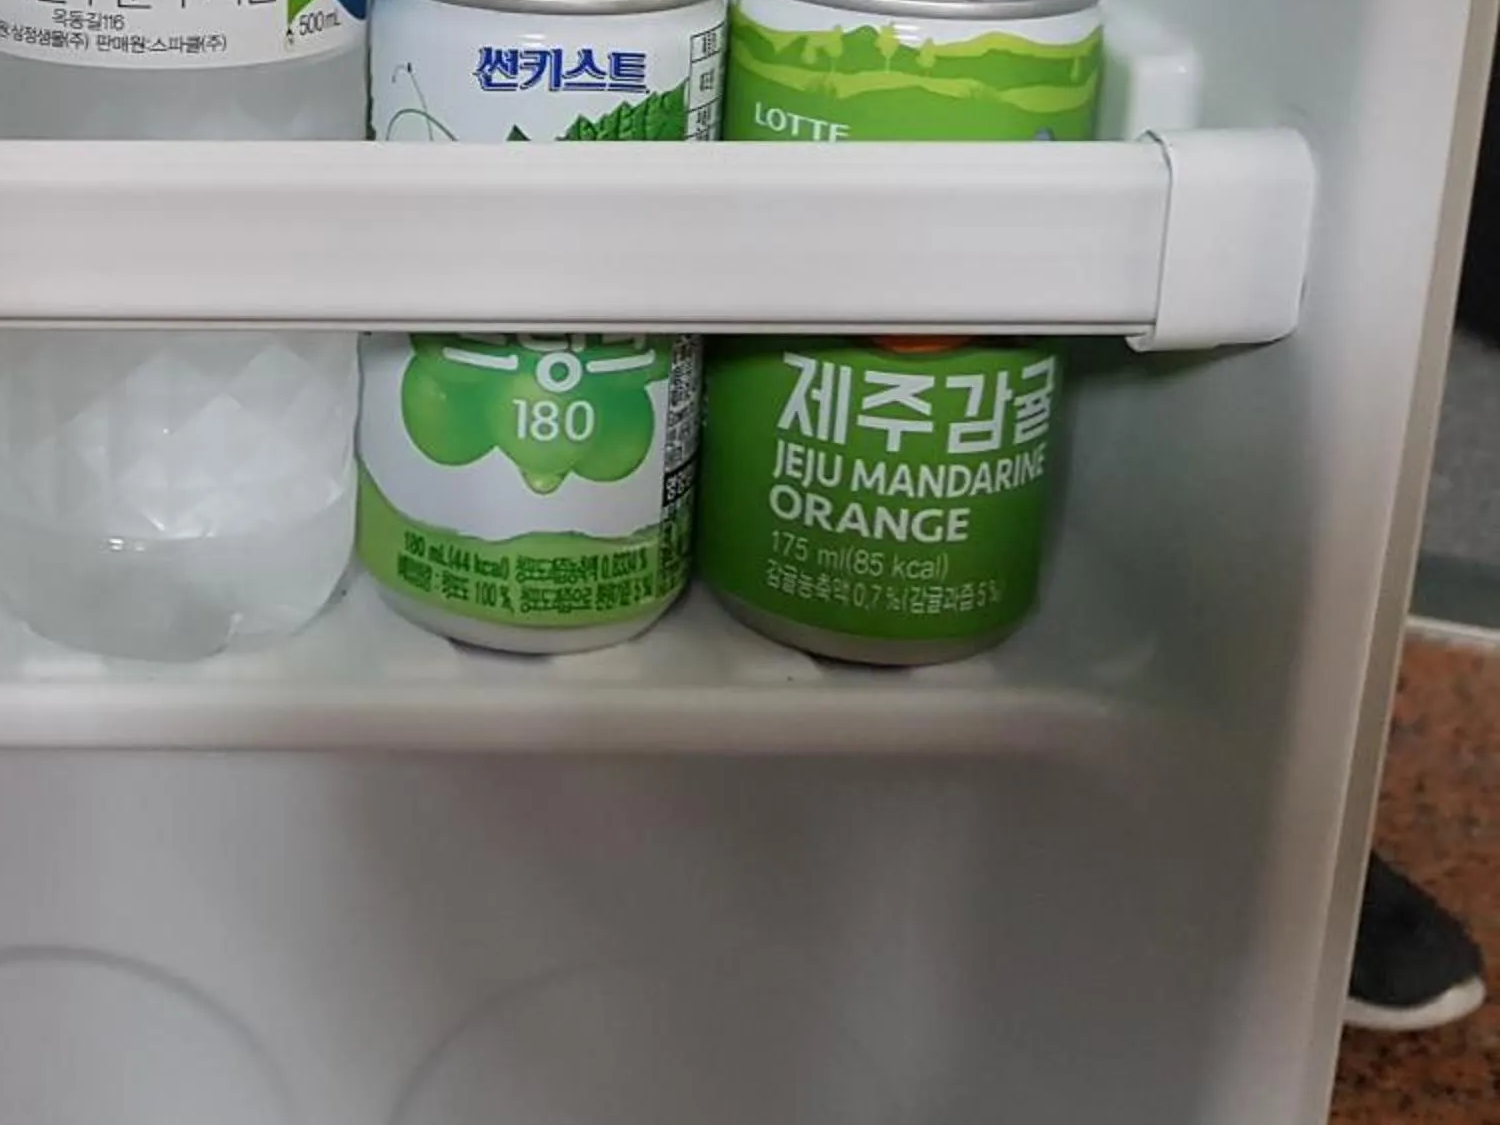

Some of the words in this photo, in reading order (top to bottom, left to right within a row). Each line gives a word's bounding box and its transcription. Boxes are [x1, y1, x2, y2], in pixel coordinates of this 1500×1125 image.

[473, 46, 650, 94] 썬키스트
[512, 399, 596, 442] 180
[778, 351, 1056, 454] 제주감귤
[773, 440, 845, 488] JEJU
[850, 442, 1047, 499] MANDARINE
[768, 485, 972, 543] ORANGE
[771, 530, 810, 562] 175
[817, 548, 885, 577] ml(85
[891, 552, 950, 582] kcal)
